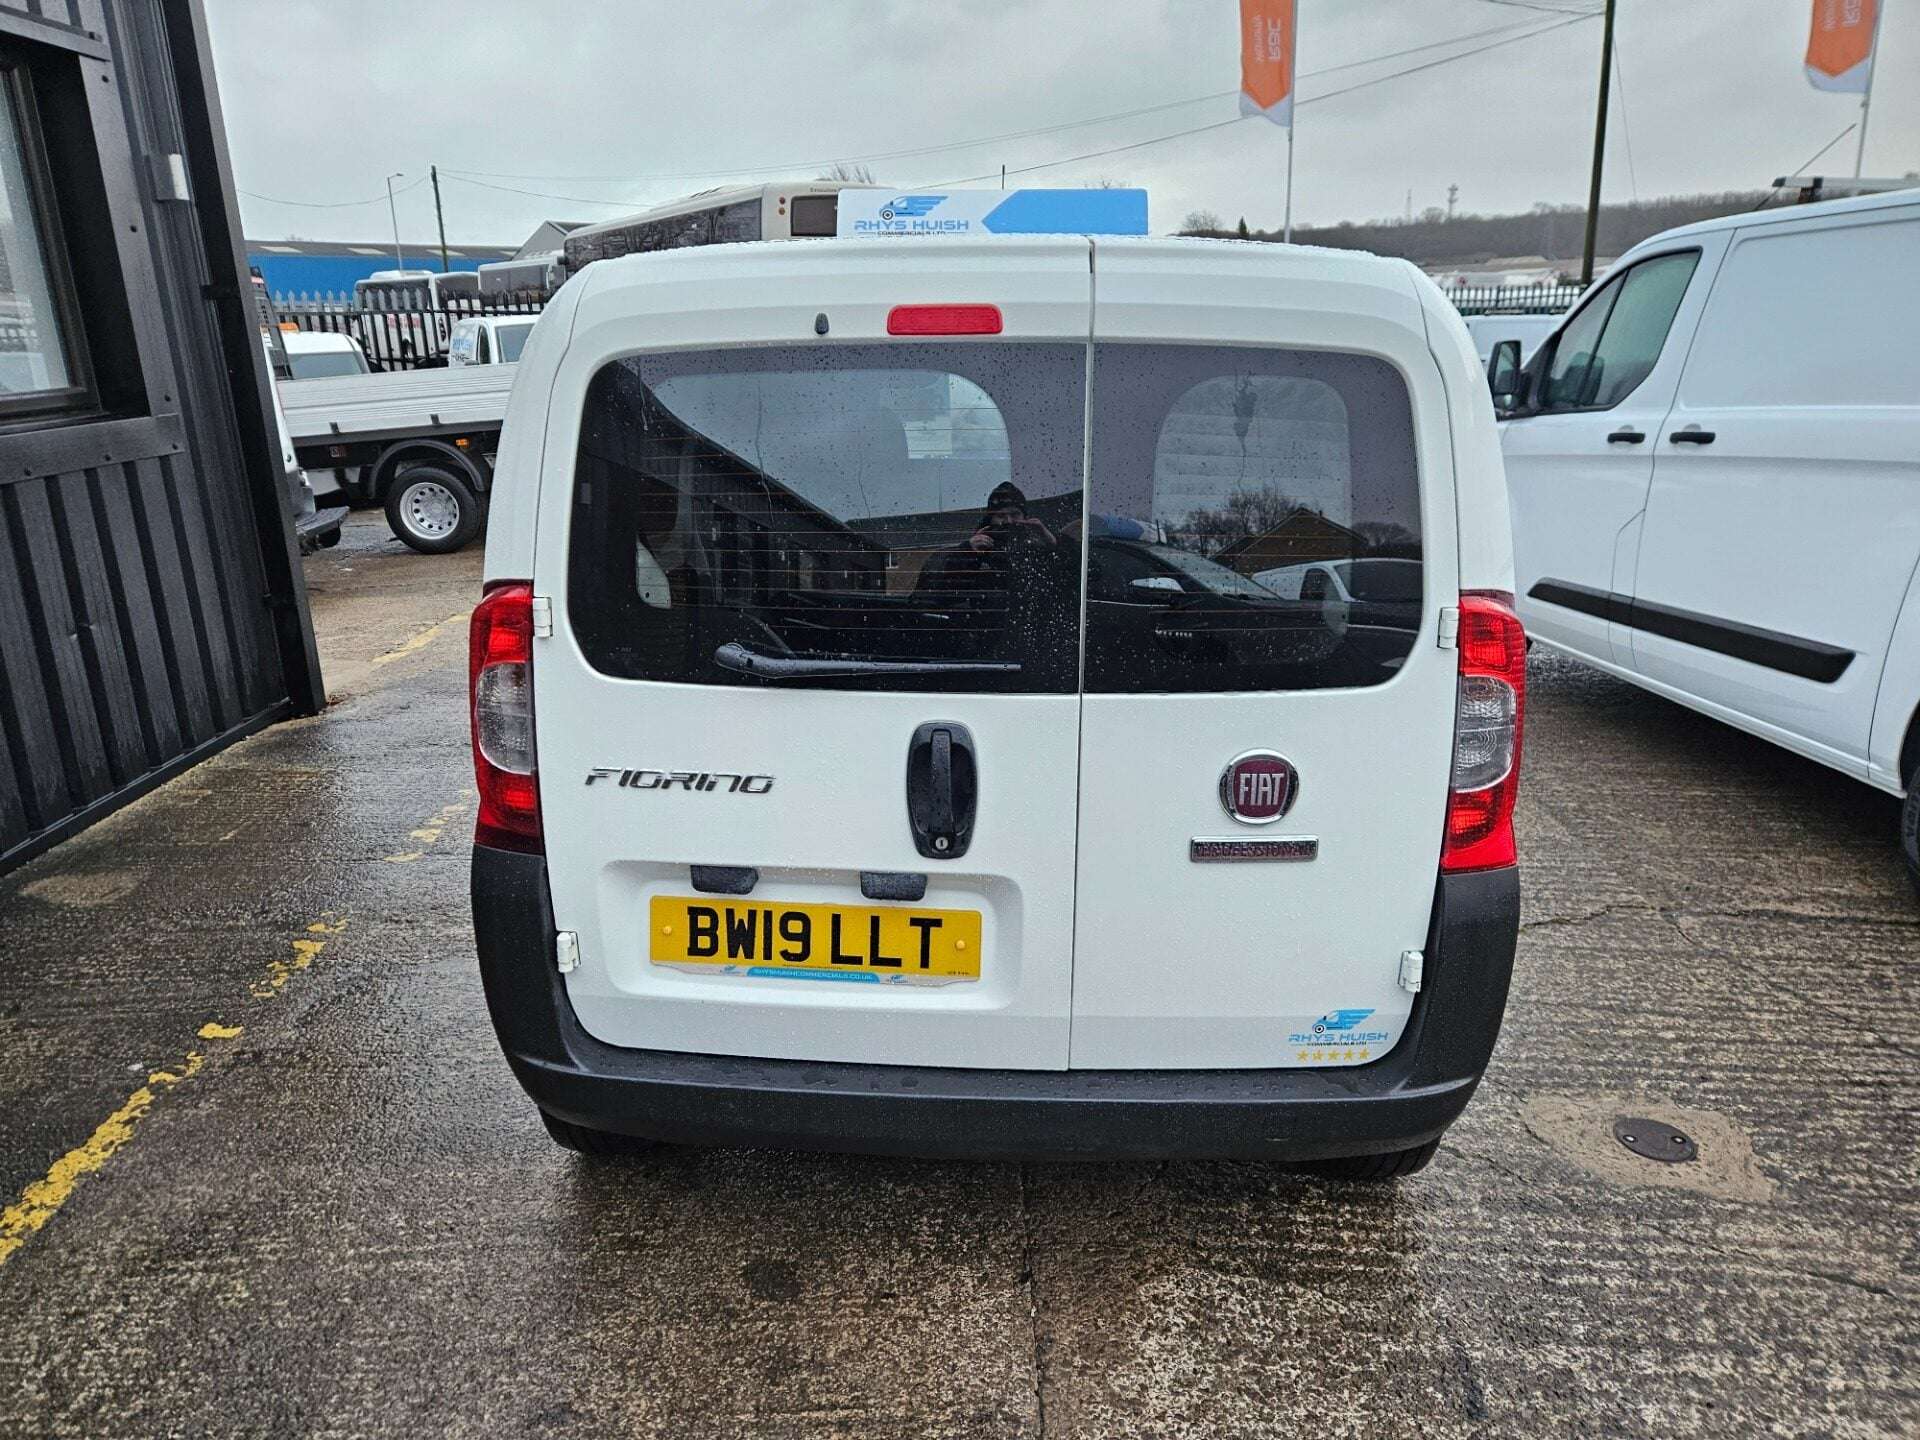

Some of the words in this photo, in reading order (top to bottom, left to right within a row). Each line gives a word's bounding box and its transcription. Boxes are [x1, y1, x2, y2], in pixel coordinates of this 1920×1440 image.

[854, 220, 906, 230] RHYS
[913, 220, 969, 230] HUISH
[585, 767, 776, 794] FIORINO
[1238, 773, 1285, 806] FIAT
[1198, 842, 1313, 857] PROFESSIONAL
[687, 906, 811, 962] BW19
[831, 913, 943, 968] LLT
[1288, 1033, 1335, 1042] RHYS
[1339, 1032, 1388, 1041] HUISH
